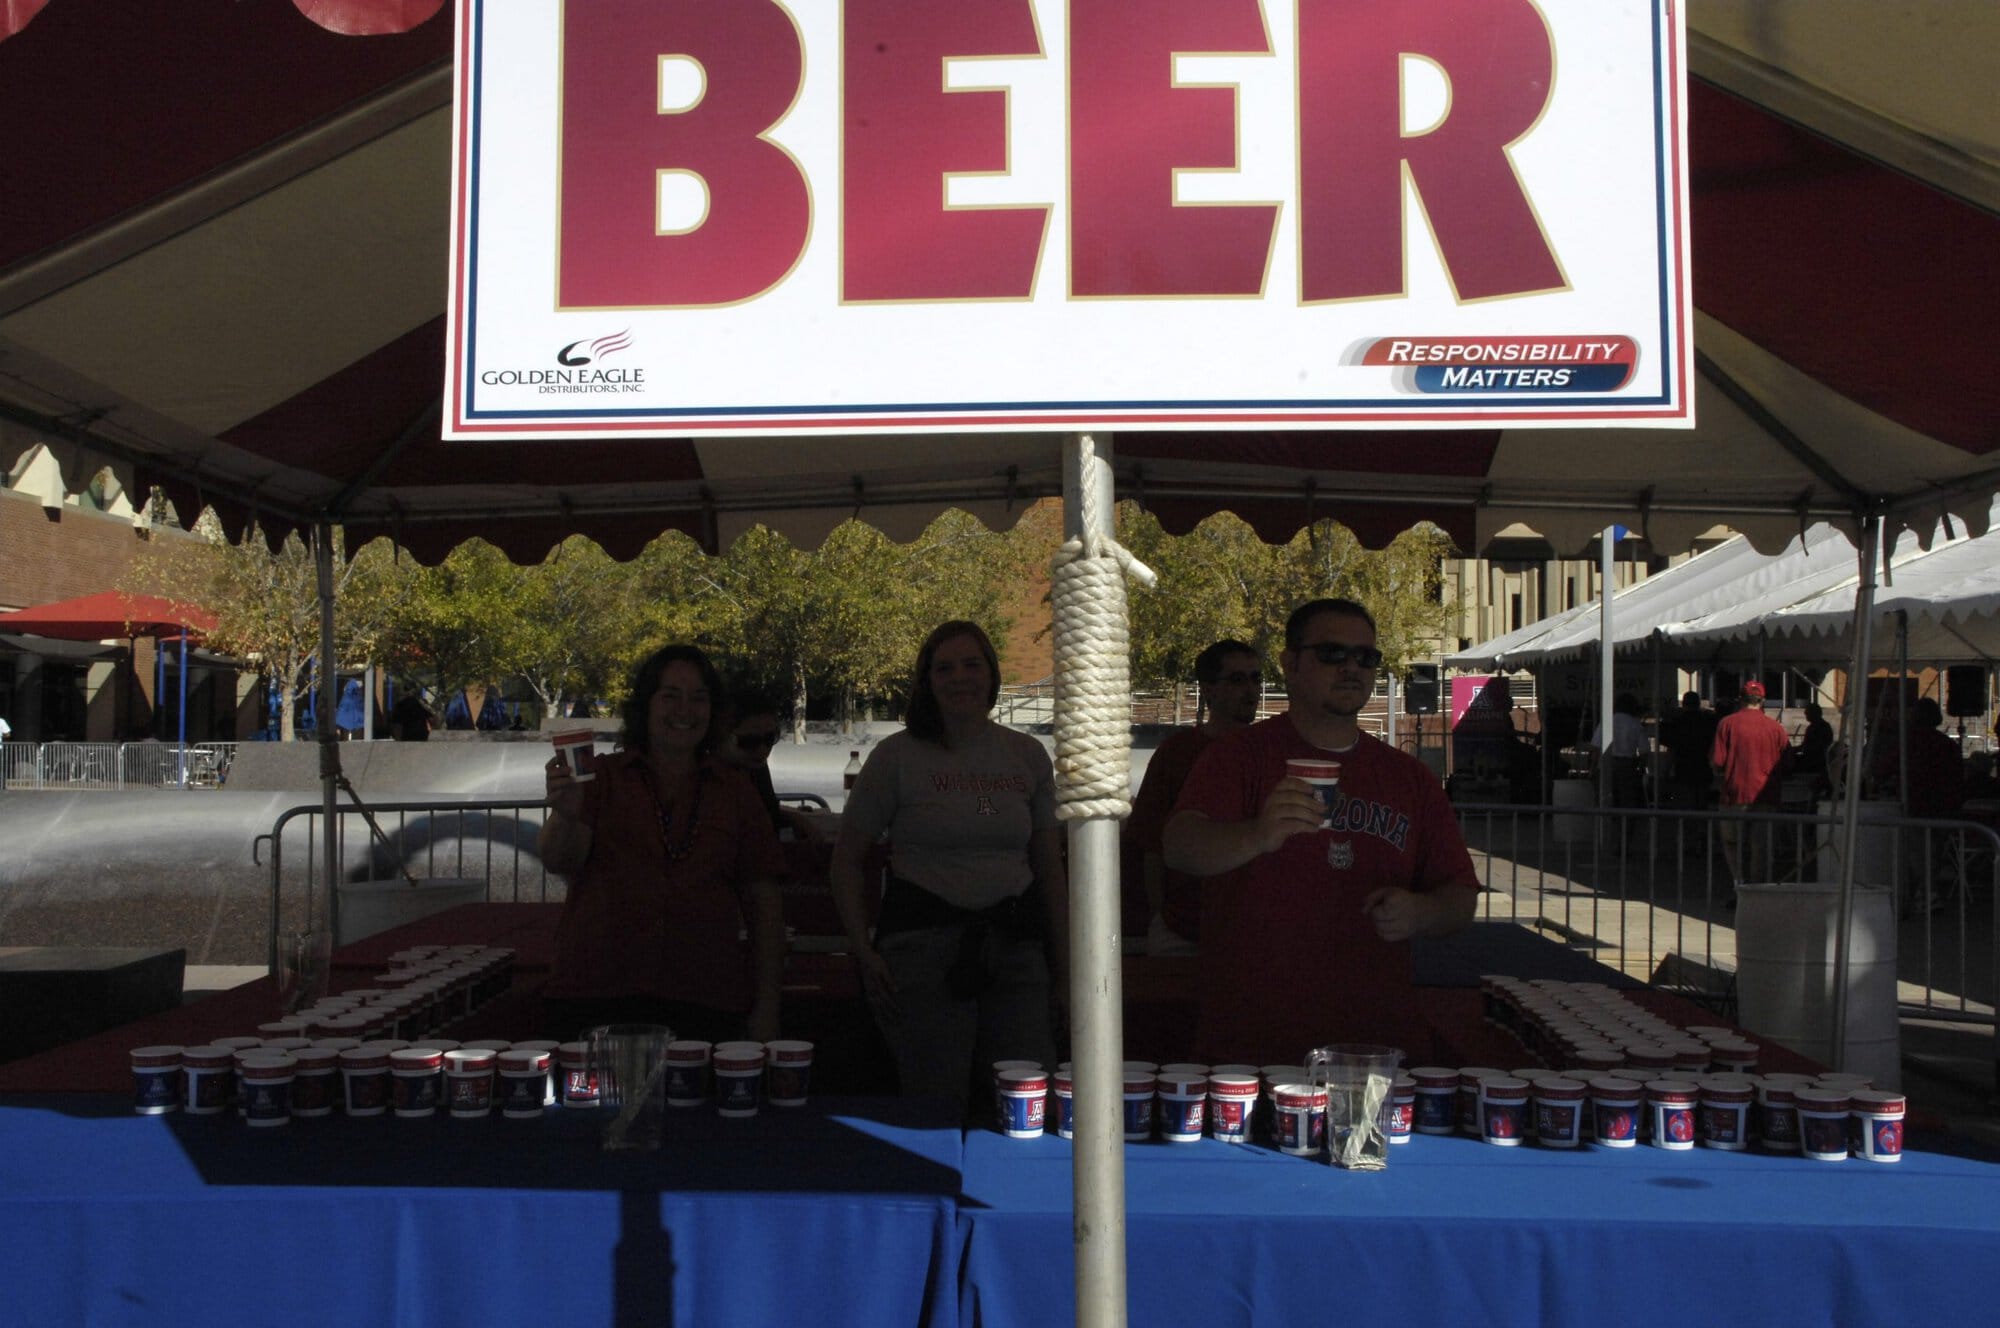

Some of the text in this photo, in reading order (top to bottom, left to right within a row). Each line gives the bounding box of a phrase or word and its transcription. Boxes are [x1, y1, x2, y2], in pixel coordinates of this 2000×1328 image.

[553, 0, 1574, 313] BEER
[1387, 340, 1620, 362] RESPONSIBILITY
[481, 368, 645, 386] GOLDEN EAGLE
[1441, 367, 1572, 387] MATTERS
[538, 384, 645, 394] DISTRIBUTORS, INC.
[1331, 794, 1410, 853] ZONA
